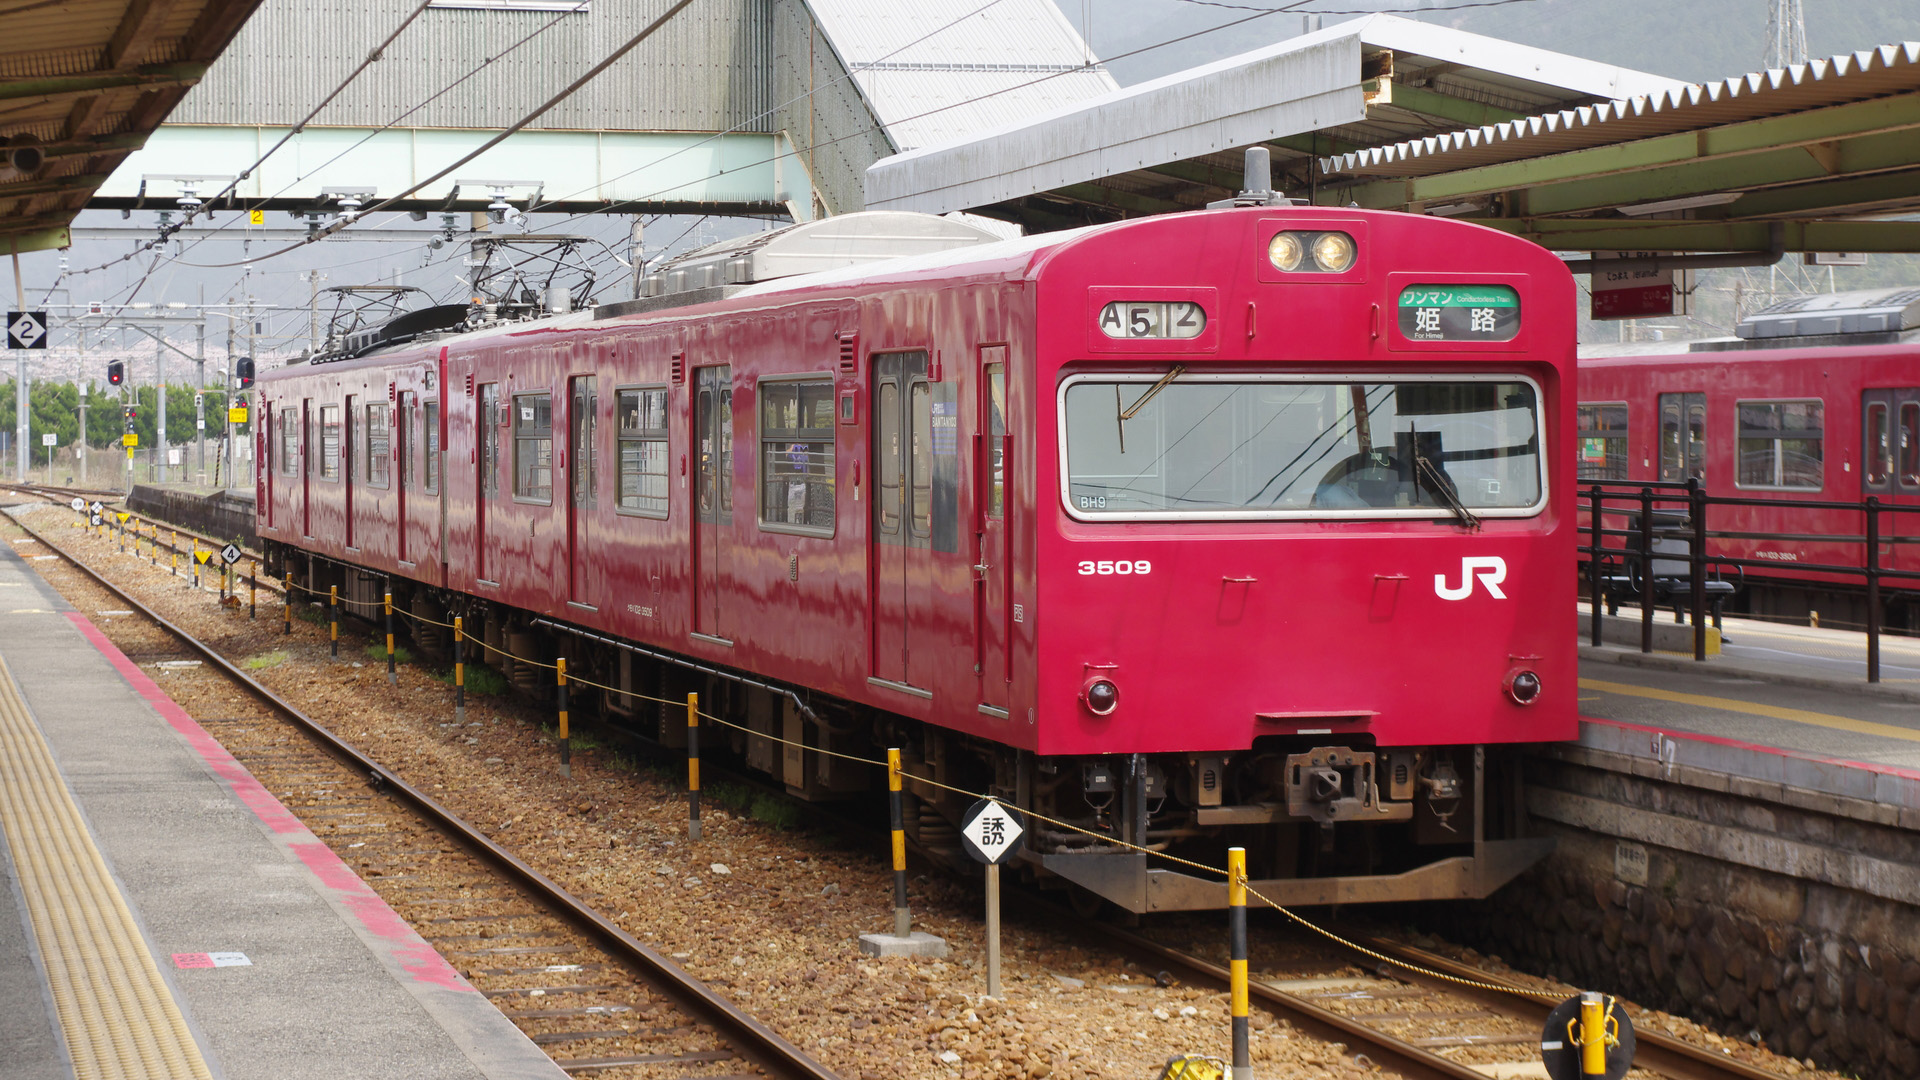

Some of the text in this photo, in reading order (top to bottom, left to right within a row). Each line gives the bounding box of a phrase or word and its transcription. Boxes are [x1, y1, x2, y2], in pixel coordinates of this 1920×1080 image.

[253, 210, 262, 222] 2
[1403, 291, 1511, 305] ワンマン Conductorless Train
[20, 321, 34, 339] 2
[1425, 332, 1444, 340] Himeji
[1080, 496, 1106, 508] BH9
[227, 549, 234, 559] 4
[1078, 560, 1152, 575] 3509
[1434, 556, 1508, 601] JR
[982, 817, 1005, 846] 誘
